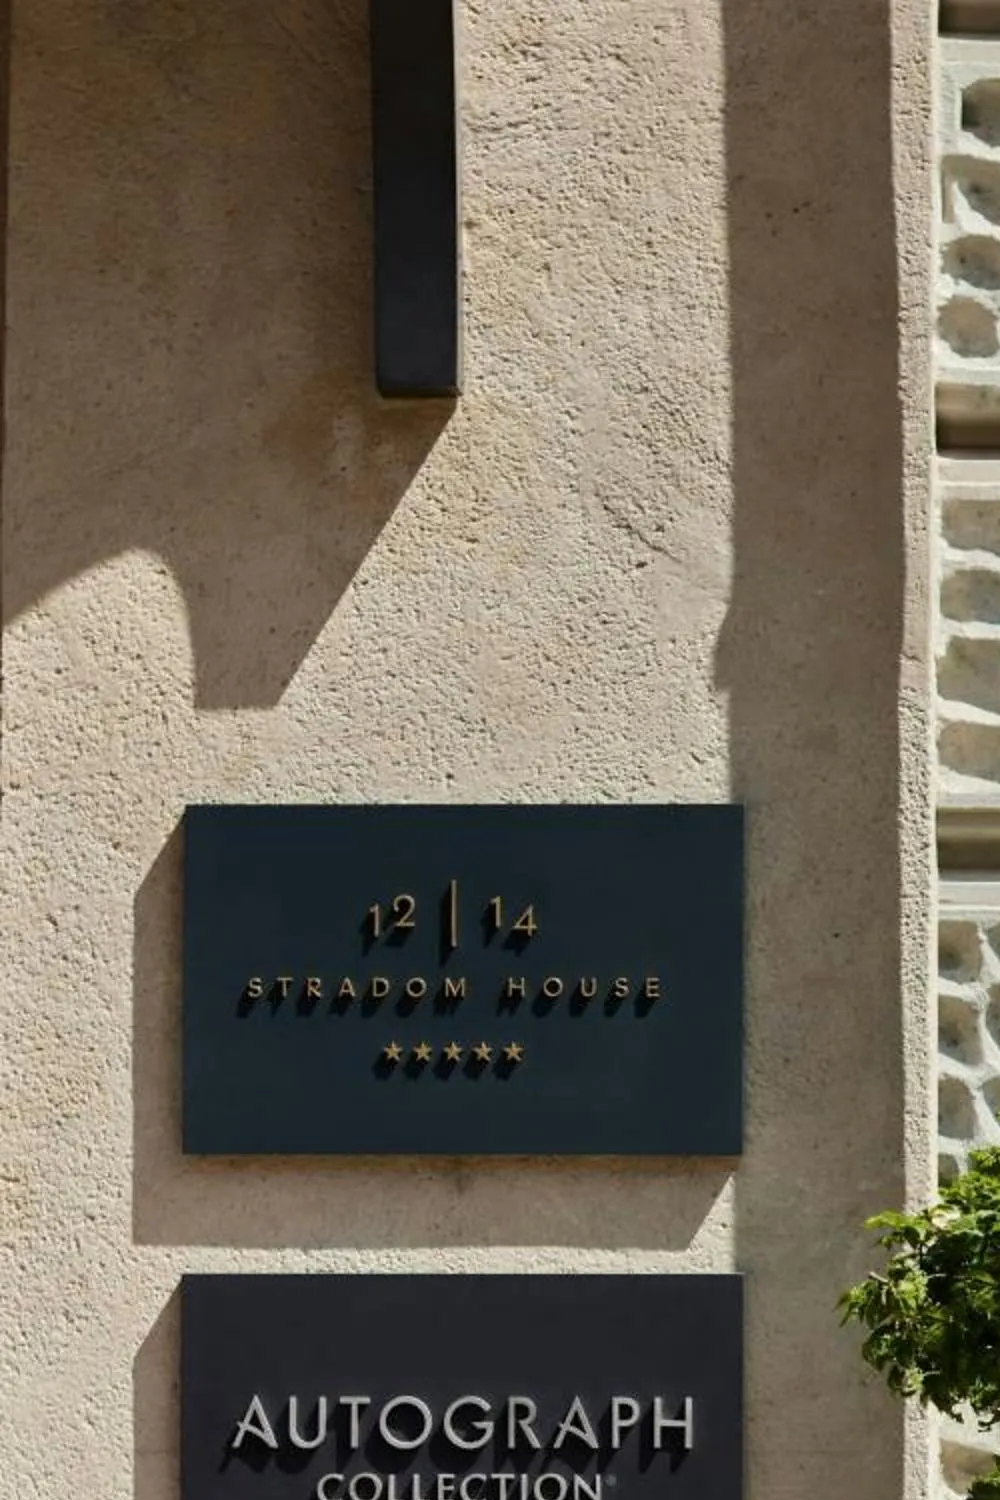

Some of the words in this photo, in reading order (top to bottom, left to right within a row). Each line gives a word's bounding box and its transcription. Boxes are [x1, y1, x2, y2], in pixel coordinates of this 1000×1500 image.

[368, 894, 417, 938] 12
[488, 895, 539, 937] 14
[246, 976, 467, 999] STRADOM
[507, 976, 662, 999] HOUSE
[230, 1394, 695, 1450] AUTOGRAPH
